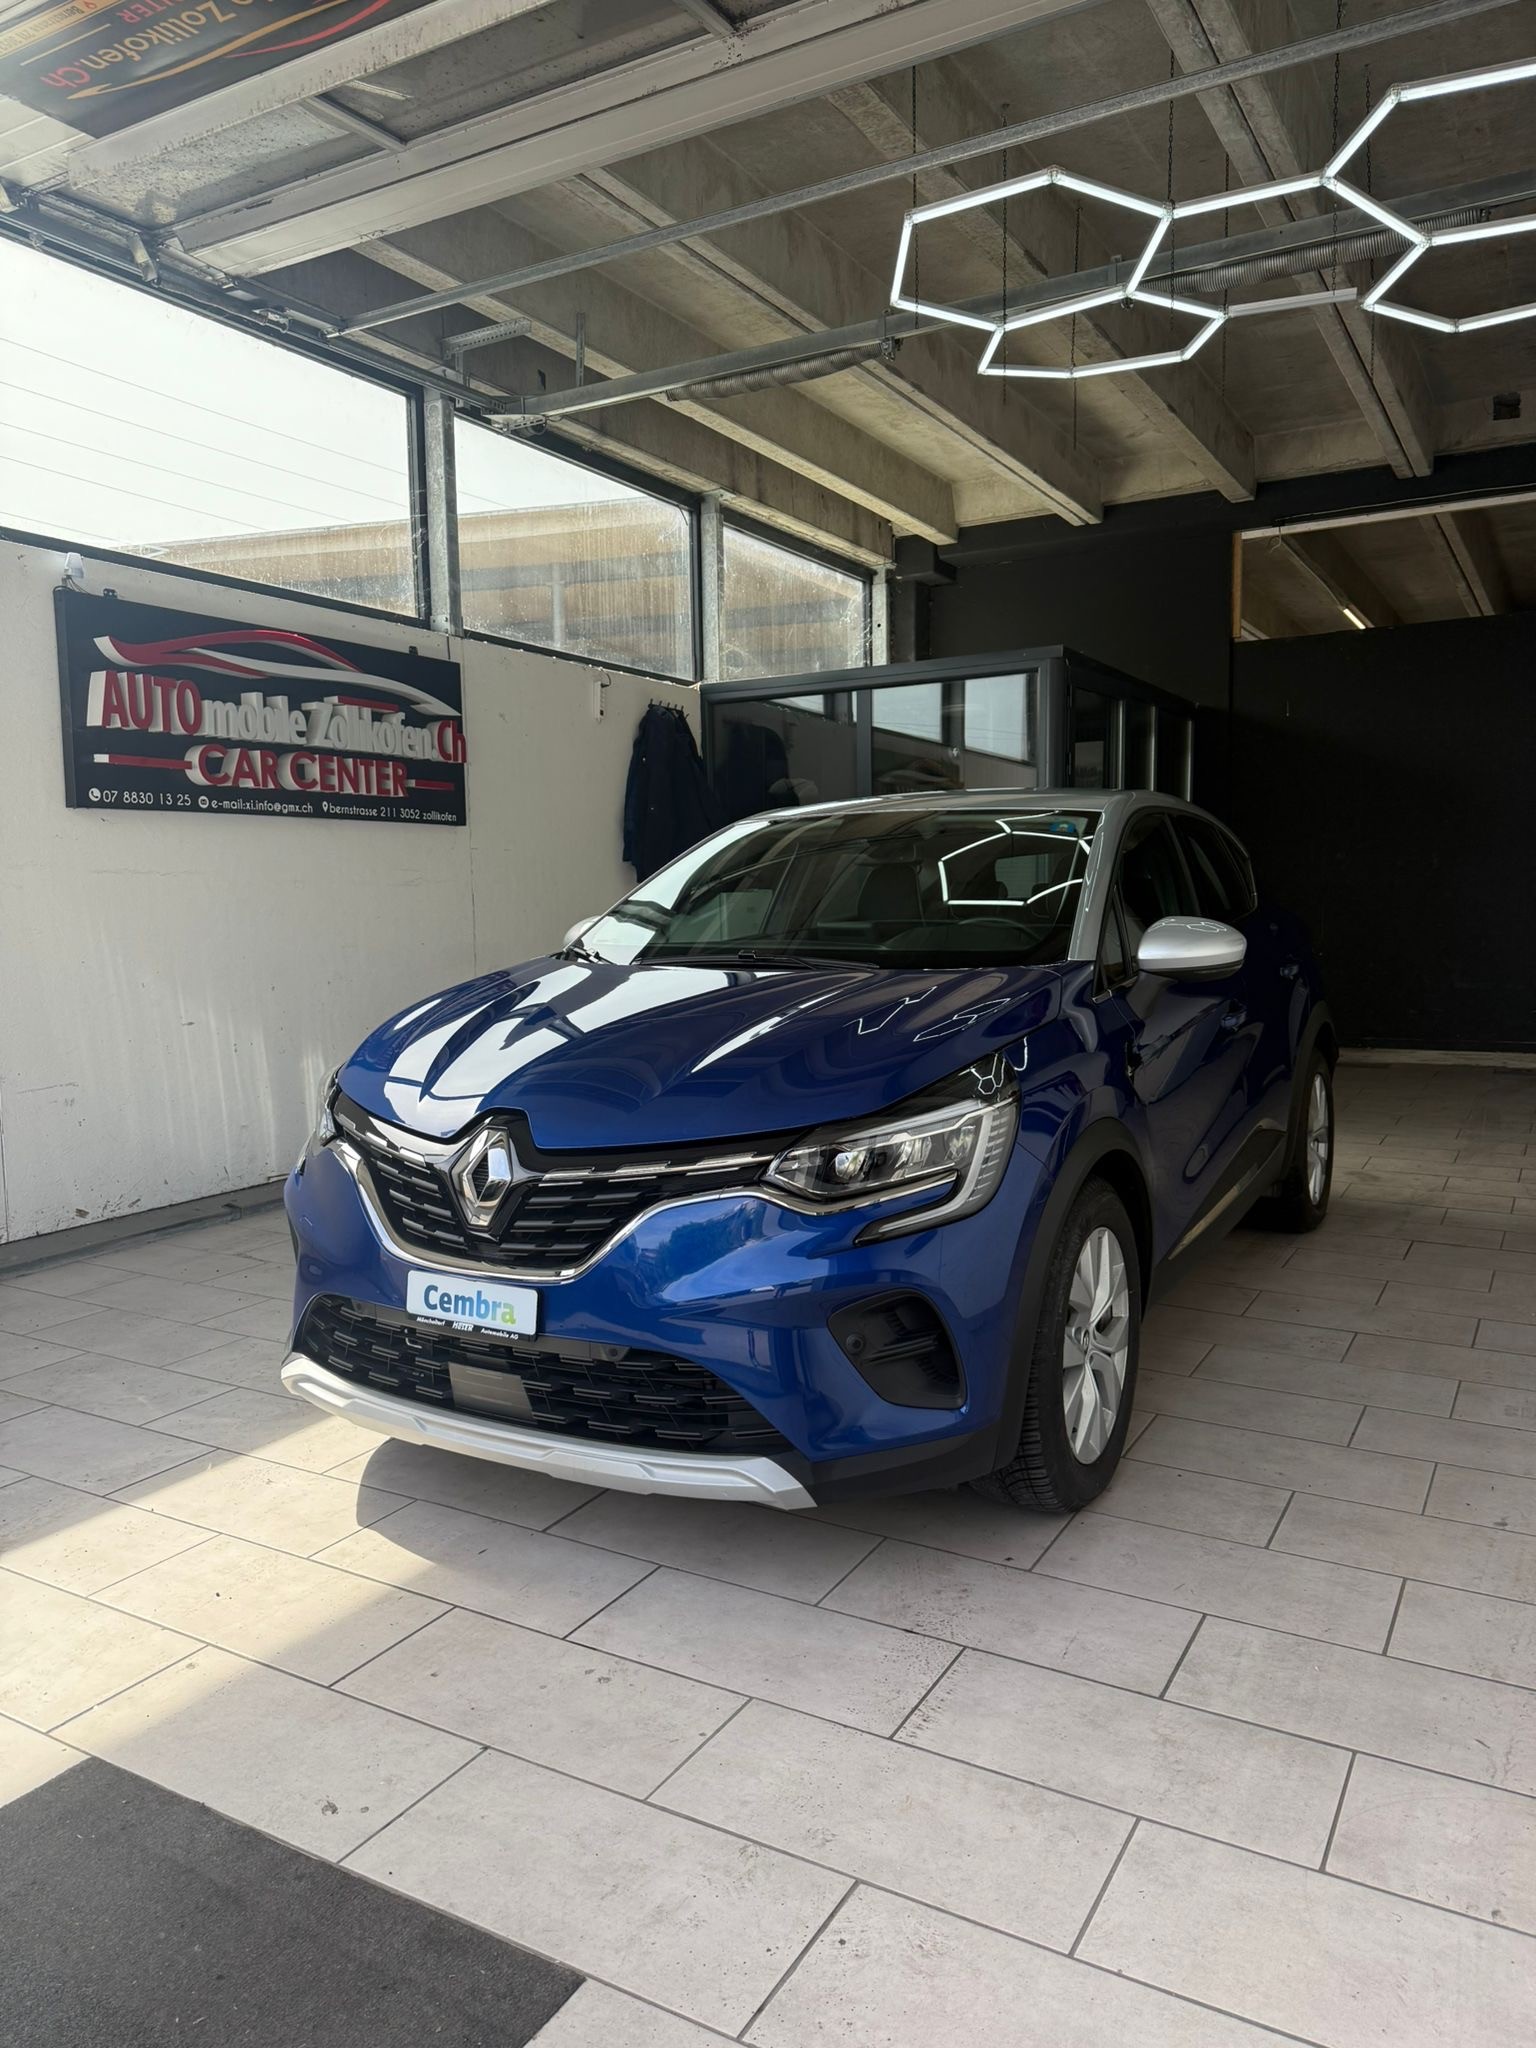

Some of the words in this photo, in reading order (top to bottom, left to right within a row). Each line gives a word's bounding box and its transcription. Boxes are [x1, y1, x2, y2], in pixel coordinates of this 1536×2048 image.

[188, 744, 282, 788] CAR
[283, 751, 408, 797] CENTER
[103, 790, 118, 803] 07
[123, 791, 154, 805] 8830
[159, 793, 173, 805] 13
[177, 794, 191, 806] 25
[329, 802, 378, 817] bernstrasse
[380, 805, 397, 818] 211
[400, 808, 421, 820] 3052
[422, 810, 457, 822] zollikofen
[424, 1285, 516, 1325] Cembra
